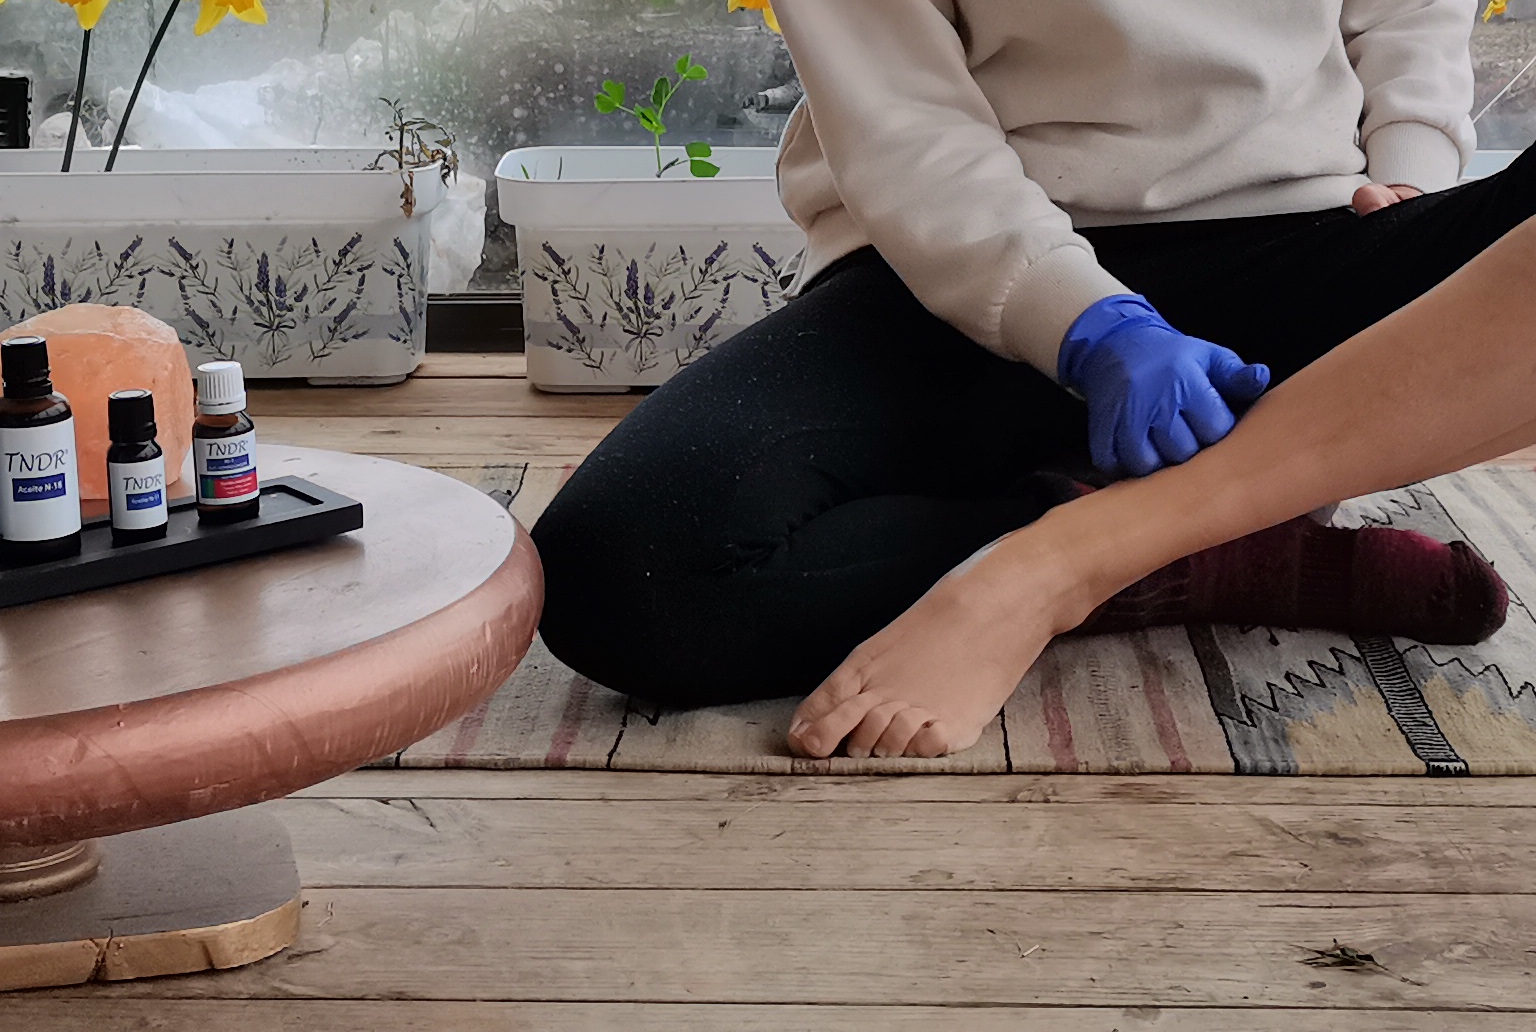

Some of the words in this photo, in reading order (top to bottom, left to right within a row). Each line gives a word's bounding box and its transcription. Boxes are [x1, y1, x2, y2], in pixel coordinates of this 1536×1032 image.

[206, 440, 246, 456] TNDR
[4, 449, 66, 473] TNDR
[123, 473, 162, 491] TNDR
